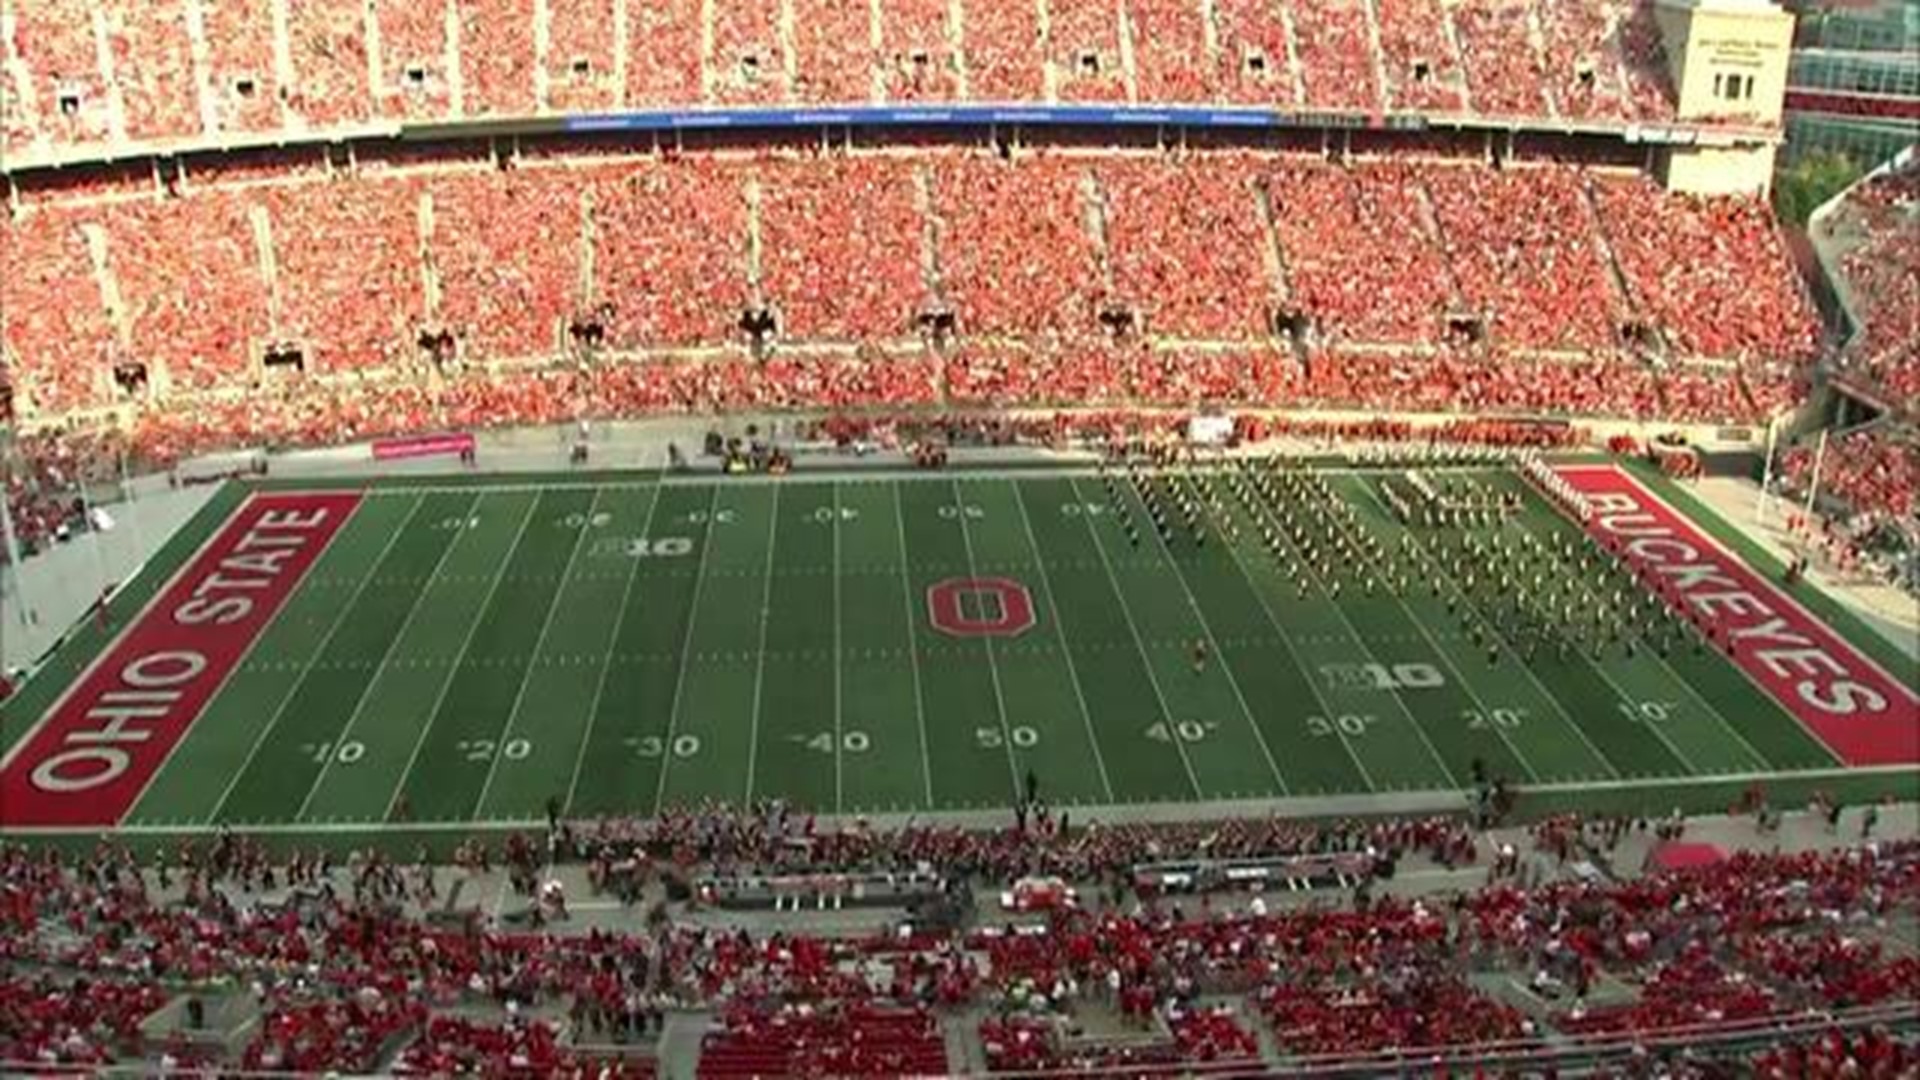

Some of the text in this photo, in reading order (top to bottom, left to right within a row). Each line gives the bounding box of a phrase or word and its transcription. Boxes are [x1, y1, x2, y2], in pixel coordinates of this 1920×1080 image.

[926, 576, 1037, 637] O
[1580, 491, 1887, 714] BUCKEYES
[31, 507, 329, 791] OHIO STATE
[805, 729, 871, 753] 40
[975, 724, 1038, 749] 50
[1145, 718, 1205, 743] 40
[312, 740, 366, 764] 10
[464, 738, 531, 762] 20
[635, 732, 700, 758] 30
